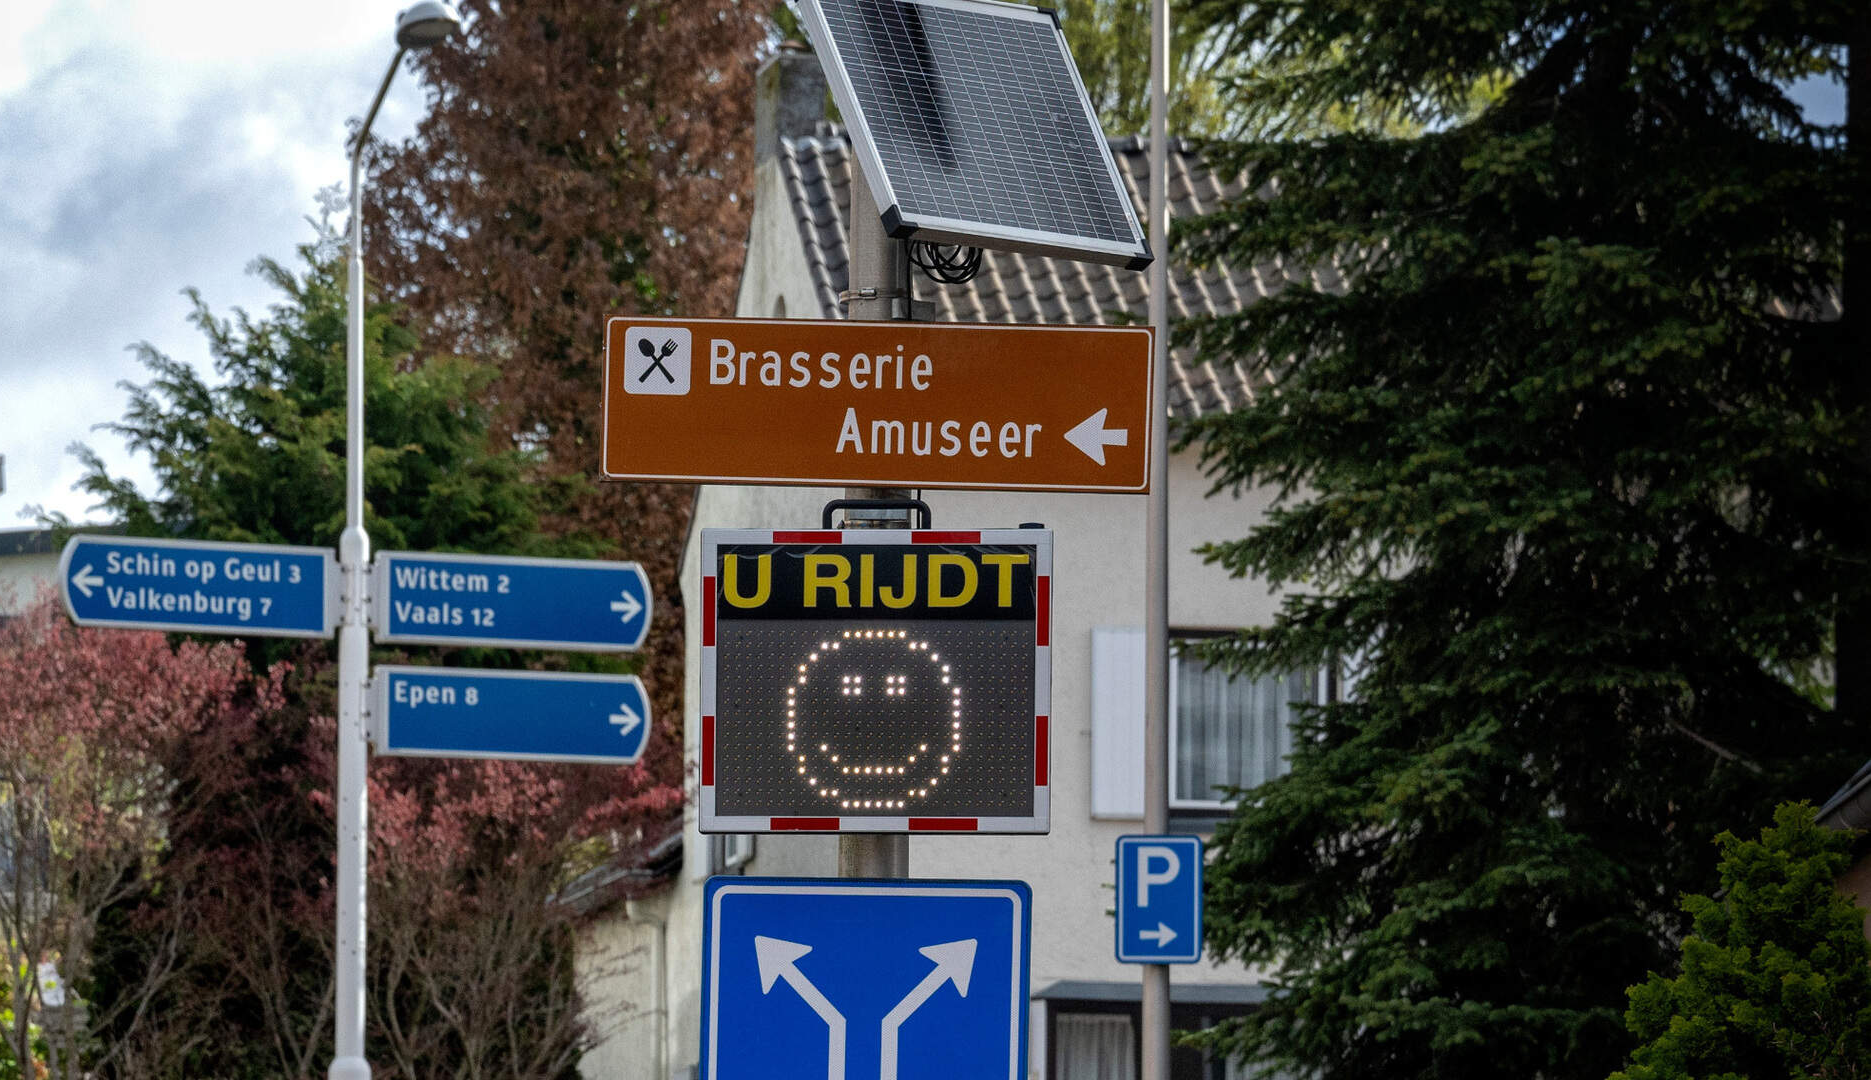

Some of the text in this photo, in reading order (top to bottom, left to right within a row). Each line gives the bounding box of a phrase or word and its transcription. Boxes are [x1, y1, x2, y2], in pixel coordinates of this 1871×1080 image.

[709, 338, 933, 391] Brasserie
[835, 407, 1043, 458] Amuseer
[106, 551, 302, 584] Schin op Geul 3
[395, 566, 511, 593] Wittem 2
[723, 553, 1030, 609] U RIJDT
[106, 585, 272, 621] Valkenburg 7
[395, 601, 495, 627] Vaals 12
[395, 681, 479, 708] Epen 8
[1137, 846, 1180, 907] P
